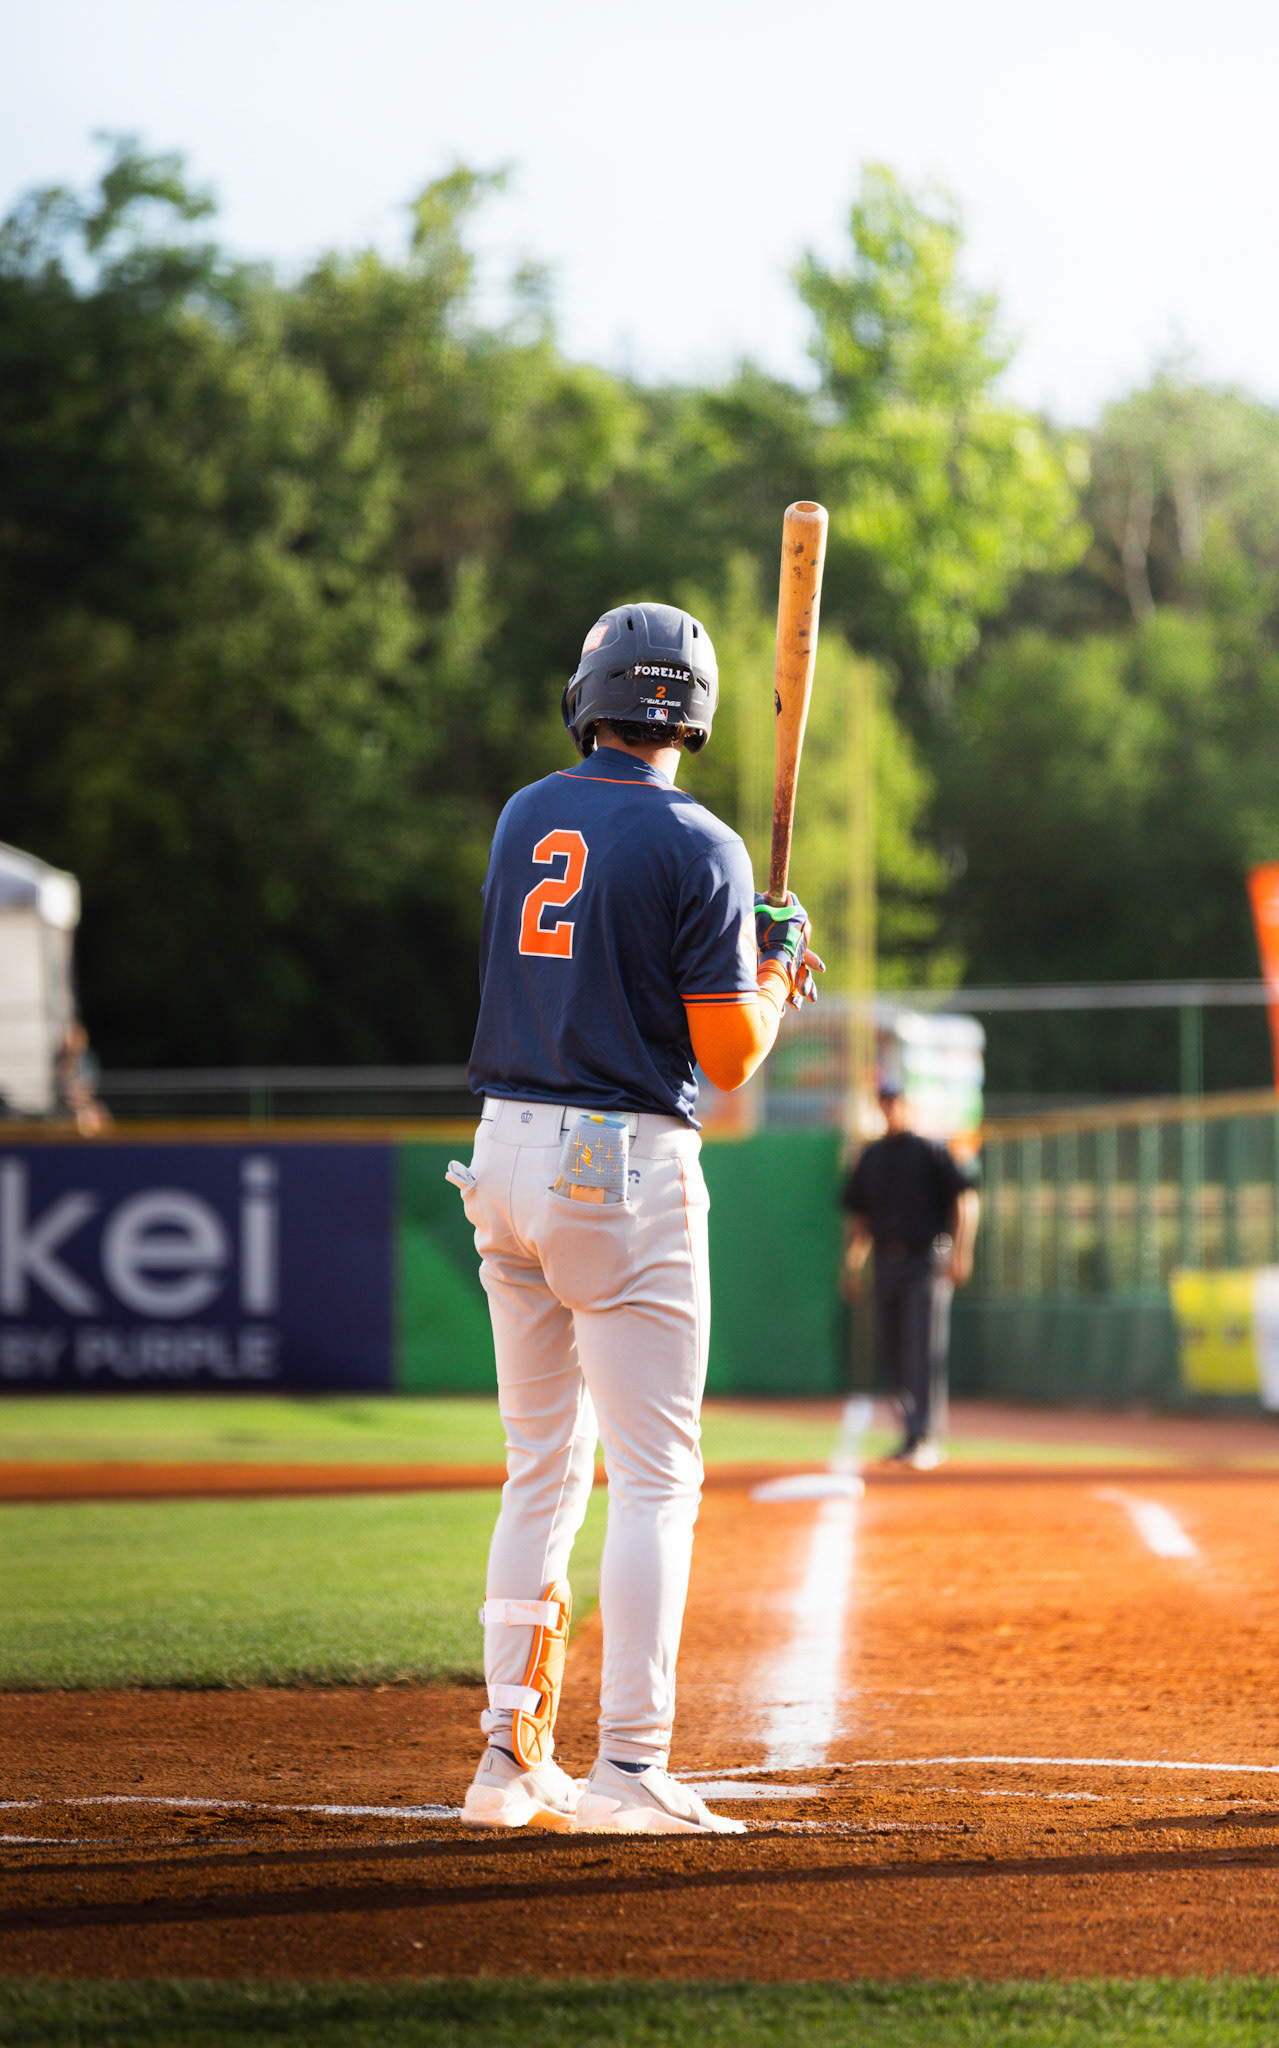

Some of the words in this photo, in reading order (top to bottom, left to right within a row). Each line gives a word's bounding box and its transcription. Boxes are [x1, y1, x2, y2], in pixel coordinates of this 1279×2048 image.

[634, 665, 690, 681] FORELLE
[656, 686, 666, 698] 2
[519, 829, 589, 959] 2
[0, 1157, 277, 1318] kei
[76, 1326, 275, 1377] PURPLE
